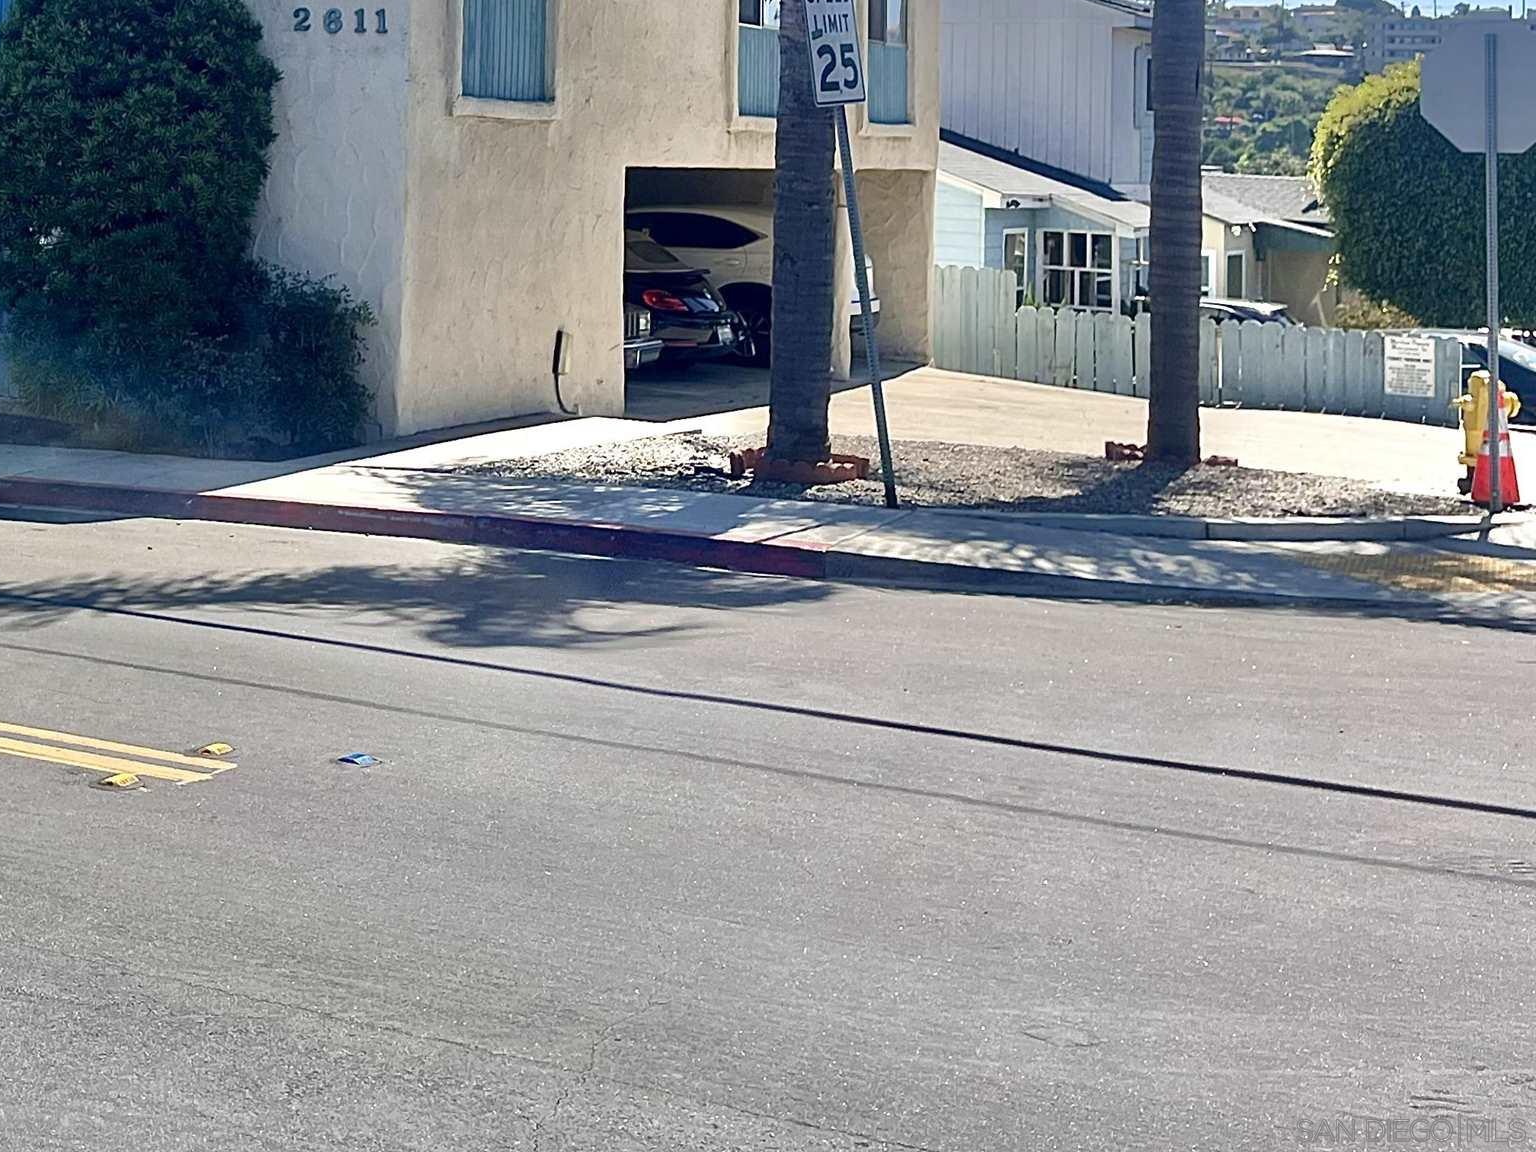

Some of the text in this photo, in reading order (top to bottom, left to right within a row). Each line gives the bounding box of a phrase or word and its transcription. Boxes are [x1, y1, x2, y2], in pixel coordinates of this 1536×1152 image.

[292, 7, 388, 34] 2611
[811, 13, 850, 40] LIMIT
[816, 43, 859, 92] 25
